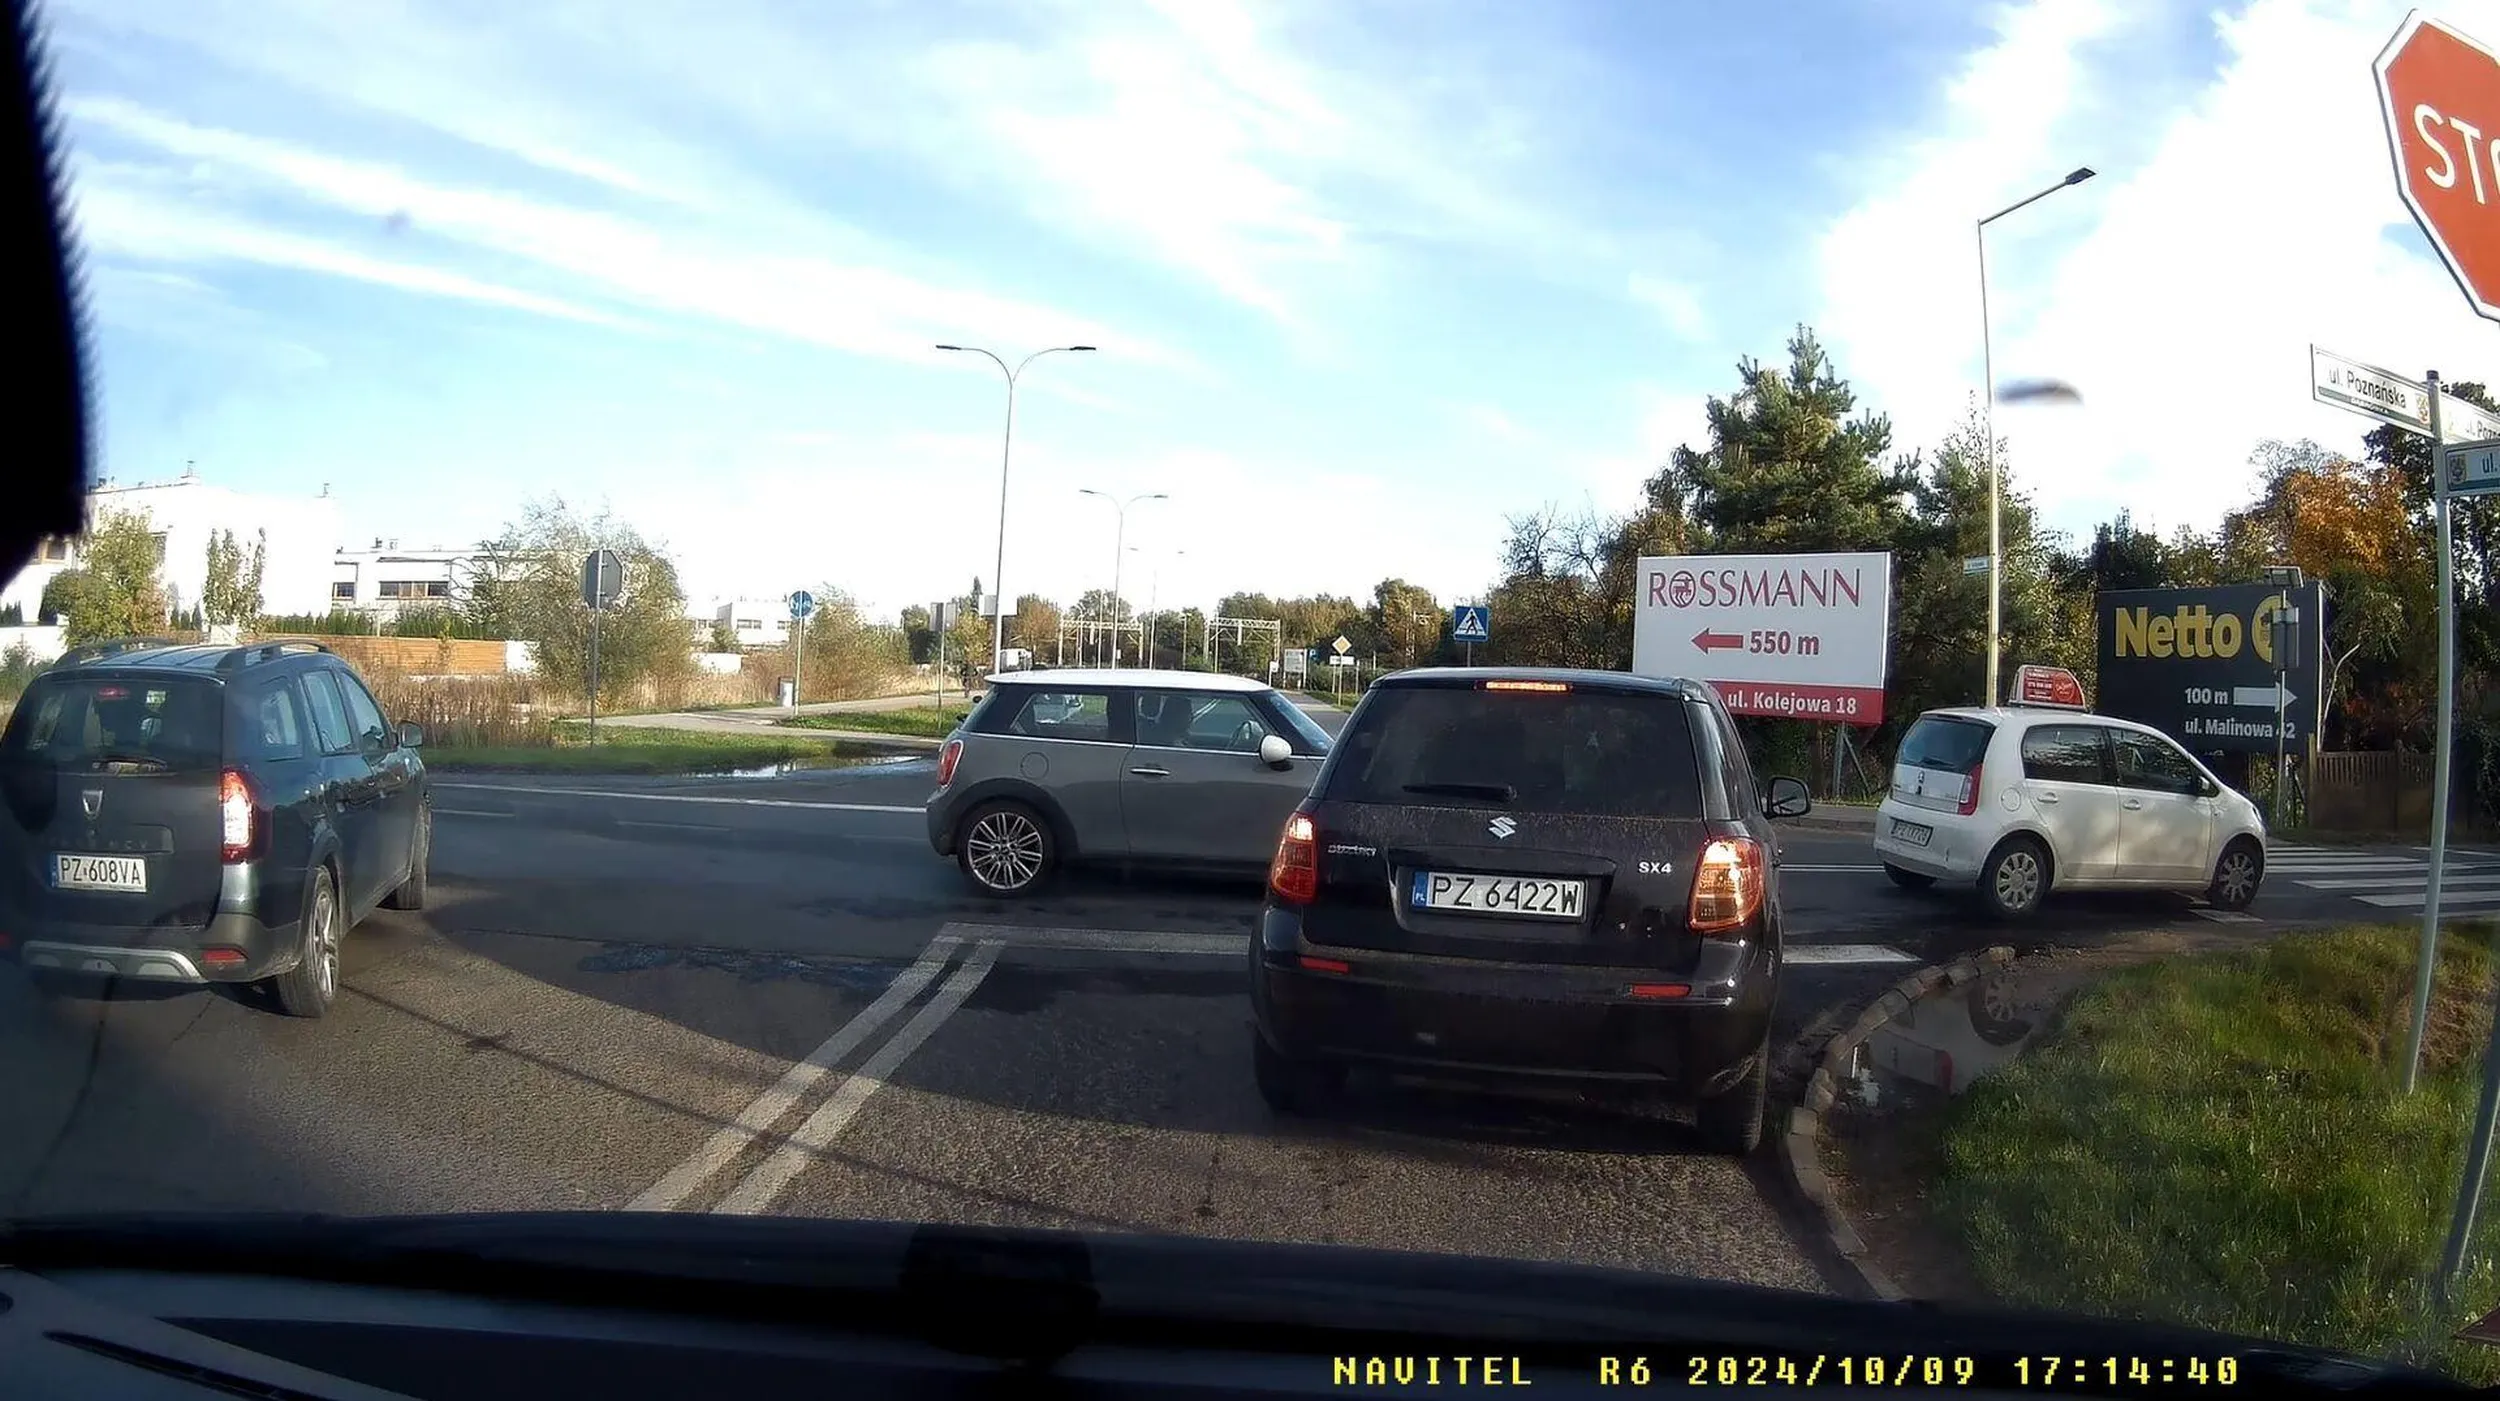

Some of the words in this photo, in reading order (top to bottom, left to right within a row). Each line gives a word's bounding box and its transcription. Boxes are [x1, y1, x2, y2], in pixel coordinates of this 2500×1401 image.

[2414, 103, 2500, 205] ST
[2328, 367, 2343, 387] ul.
[2347, 370, 2407, 409] Poznańska
[1648, 568, 1861, 608] ROSSMANN
[1750, 631, 1791, 655] 550
[1797, 635, 1820, 656] m
[2115, 604, 2242, 658] Netto
[1728, 689, 1748, 708] ul.
[1753, 692, 1831, 714] Kolejowa
[1835, 697, 1857, 715] 18
[2184, 687, 2211, 705] 100
[2214, 691, 2229, 705] m
[2185, 717, 2202, 734] ul.
[2205, 717, 2273, 738] Malinowa
[60, 857, 83, 882] PZ
[89, 859, 142, 885] 608VA
[1638, 861, 1672, 875] SX4
[1432, 876, 1475, 907] PZ
[1485, 880, 1579, 914] 6422W
